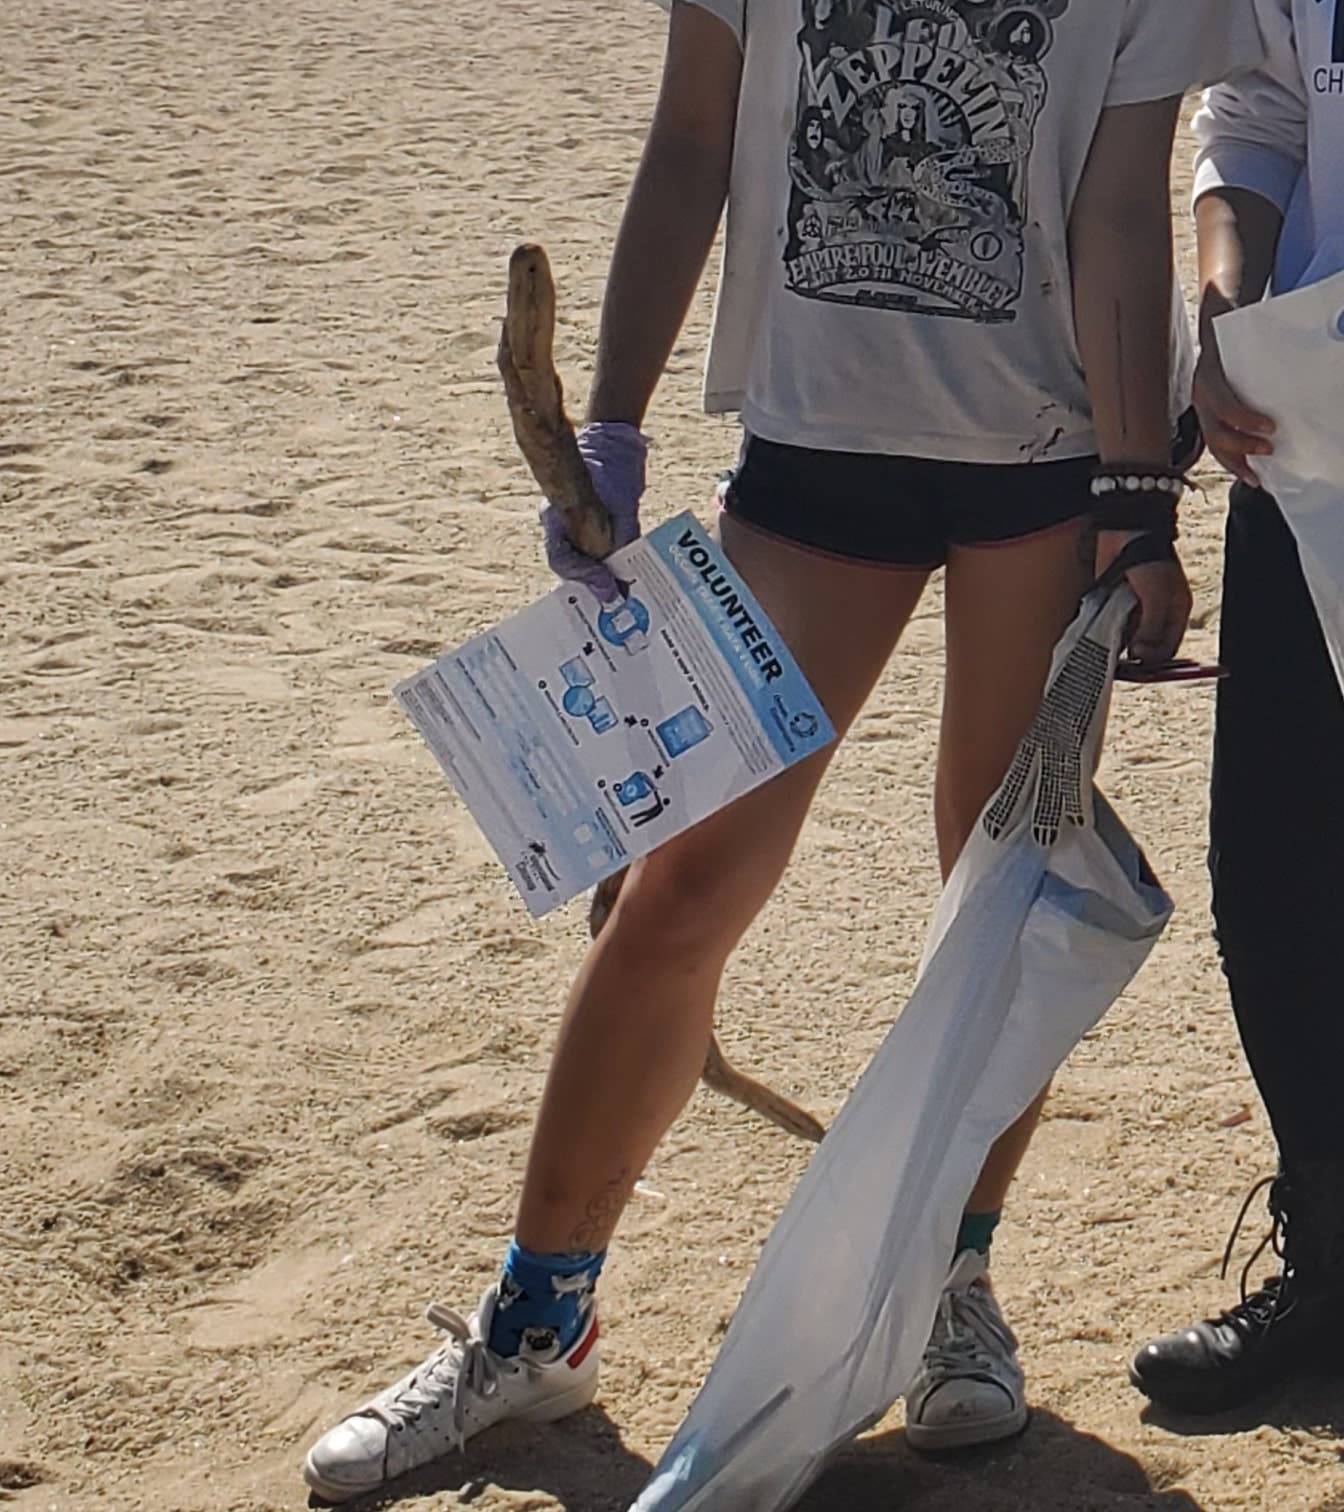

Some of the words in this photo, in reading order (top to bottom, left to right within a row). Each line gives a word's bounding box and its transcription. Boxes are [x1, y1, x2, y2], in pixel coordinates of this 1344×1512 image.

[870, 4, 969, 51] LED
[803, 41, 1011, 144] ZEPPELIN
[677, 528, 783, 684] VOLUNTEER
